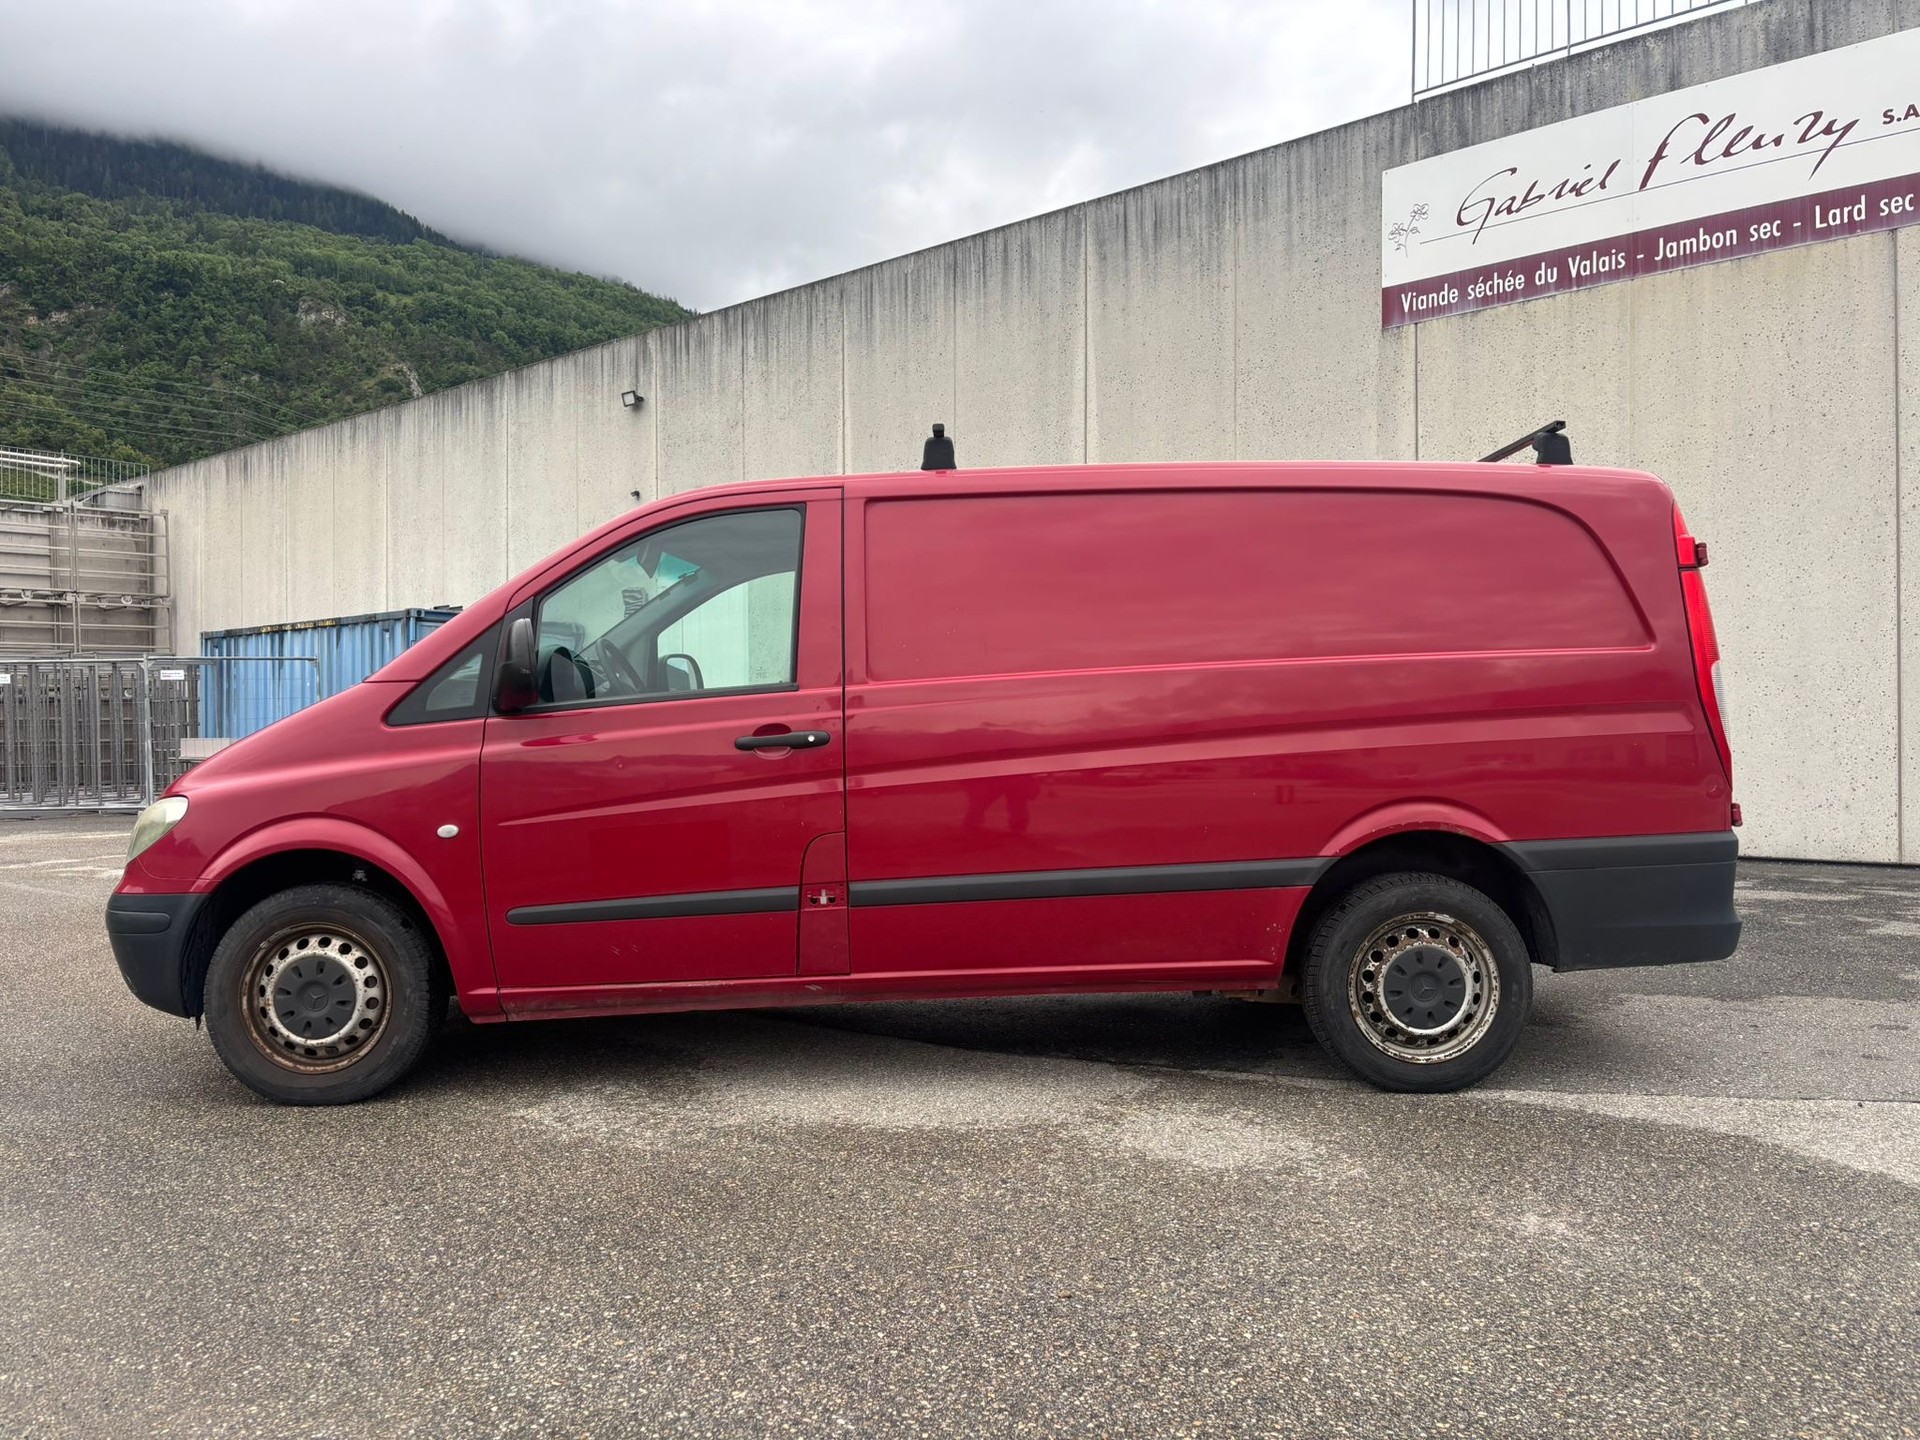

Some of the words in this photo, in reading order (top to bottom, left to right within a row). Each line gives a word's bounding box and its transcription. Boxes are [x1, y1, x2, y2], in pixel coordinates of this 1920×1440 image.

[1401, 283, 1459, 313] Viande
[1467, 270, 1526, 301] séchée
[1535, 262, 1558, 286] du
[1568, 248, 1626, 279] Valais
[1654, 228, 1737, 261] Jambon
[1749, 219, 1782, 242] sec
[1815, 195, 1867, 229] Lard
[1880, 193, 1915, 217] sec
[1456, 159, 1621, 245] Gabriel
